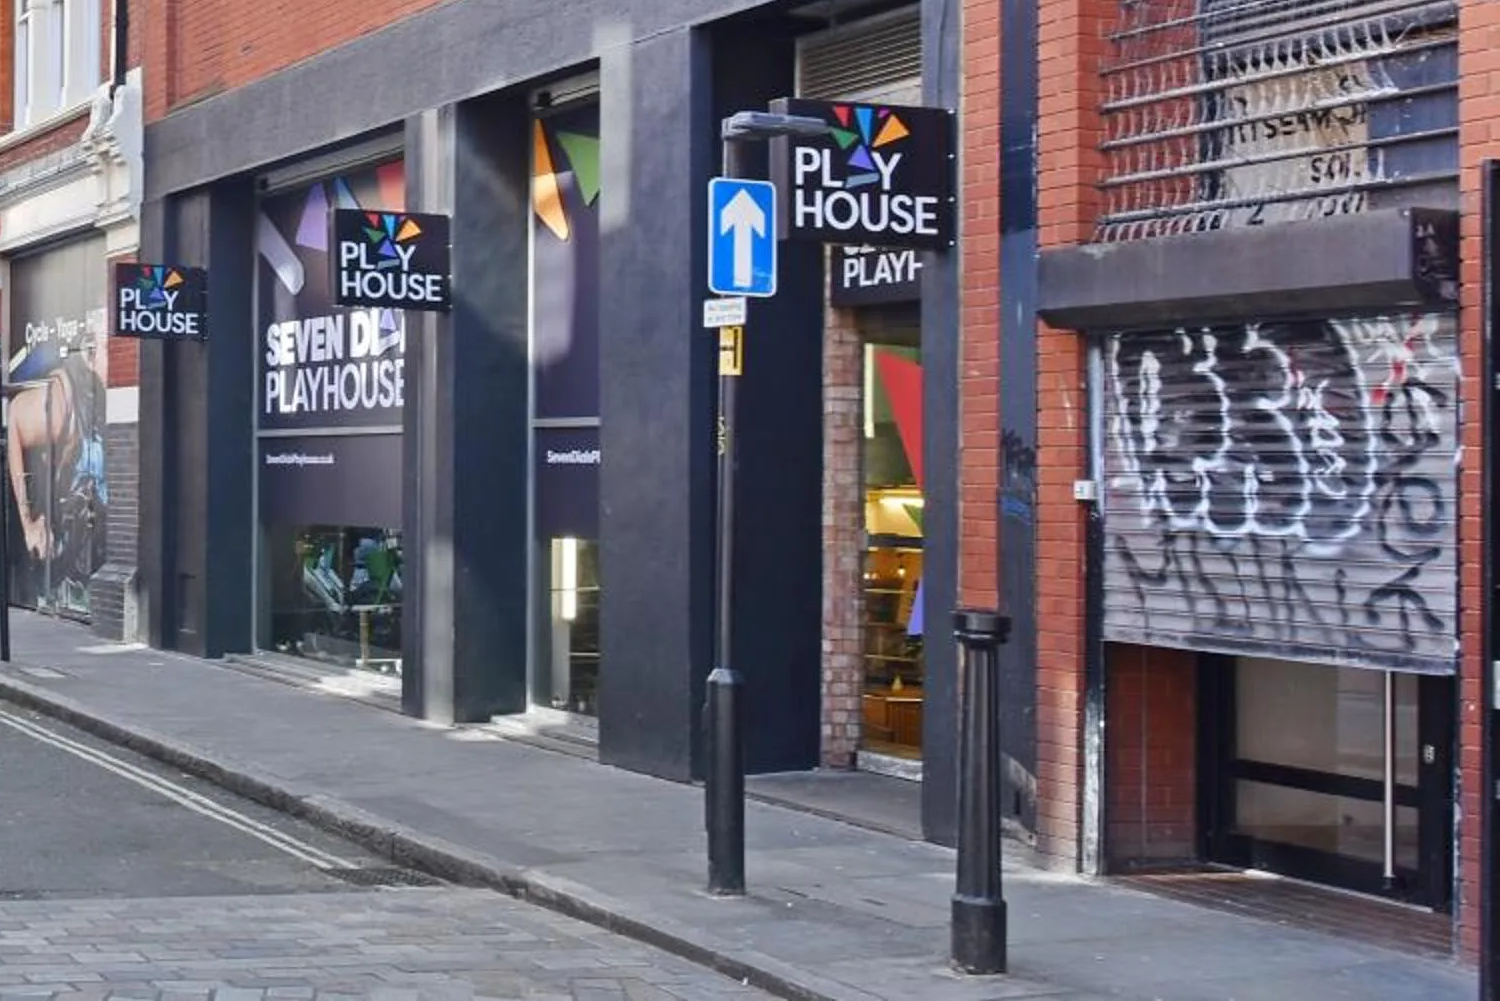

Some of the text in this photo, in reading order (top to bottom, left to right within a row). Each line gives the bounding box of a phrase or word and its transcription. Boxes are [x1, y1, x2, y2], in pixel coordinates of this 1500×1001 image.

[795, 188, 939, 235] HOUSE
[341, 270, 443, 302] HOUSE
[120, 310, 199, 335] HOUSE
[266, 313, 345, 368] SEVEN
[265, 358, 405, 414] PLAYHOUSE
